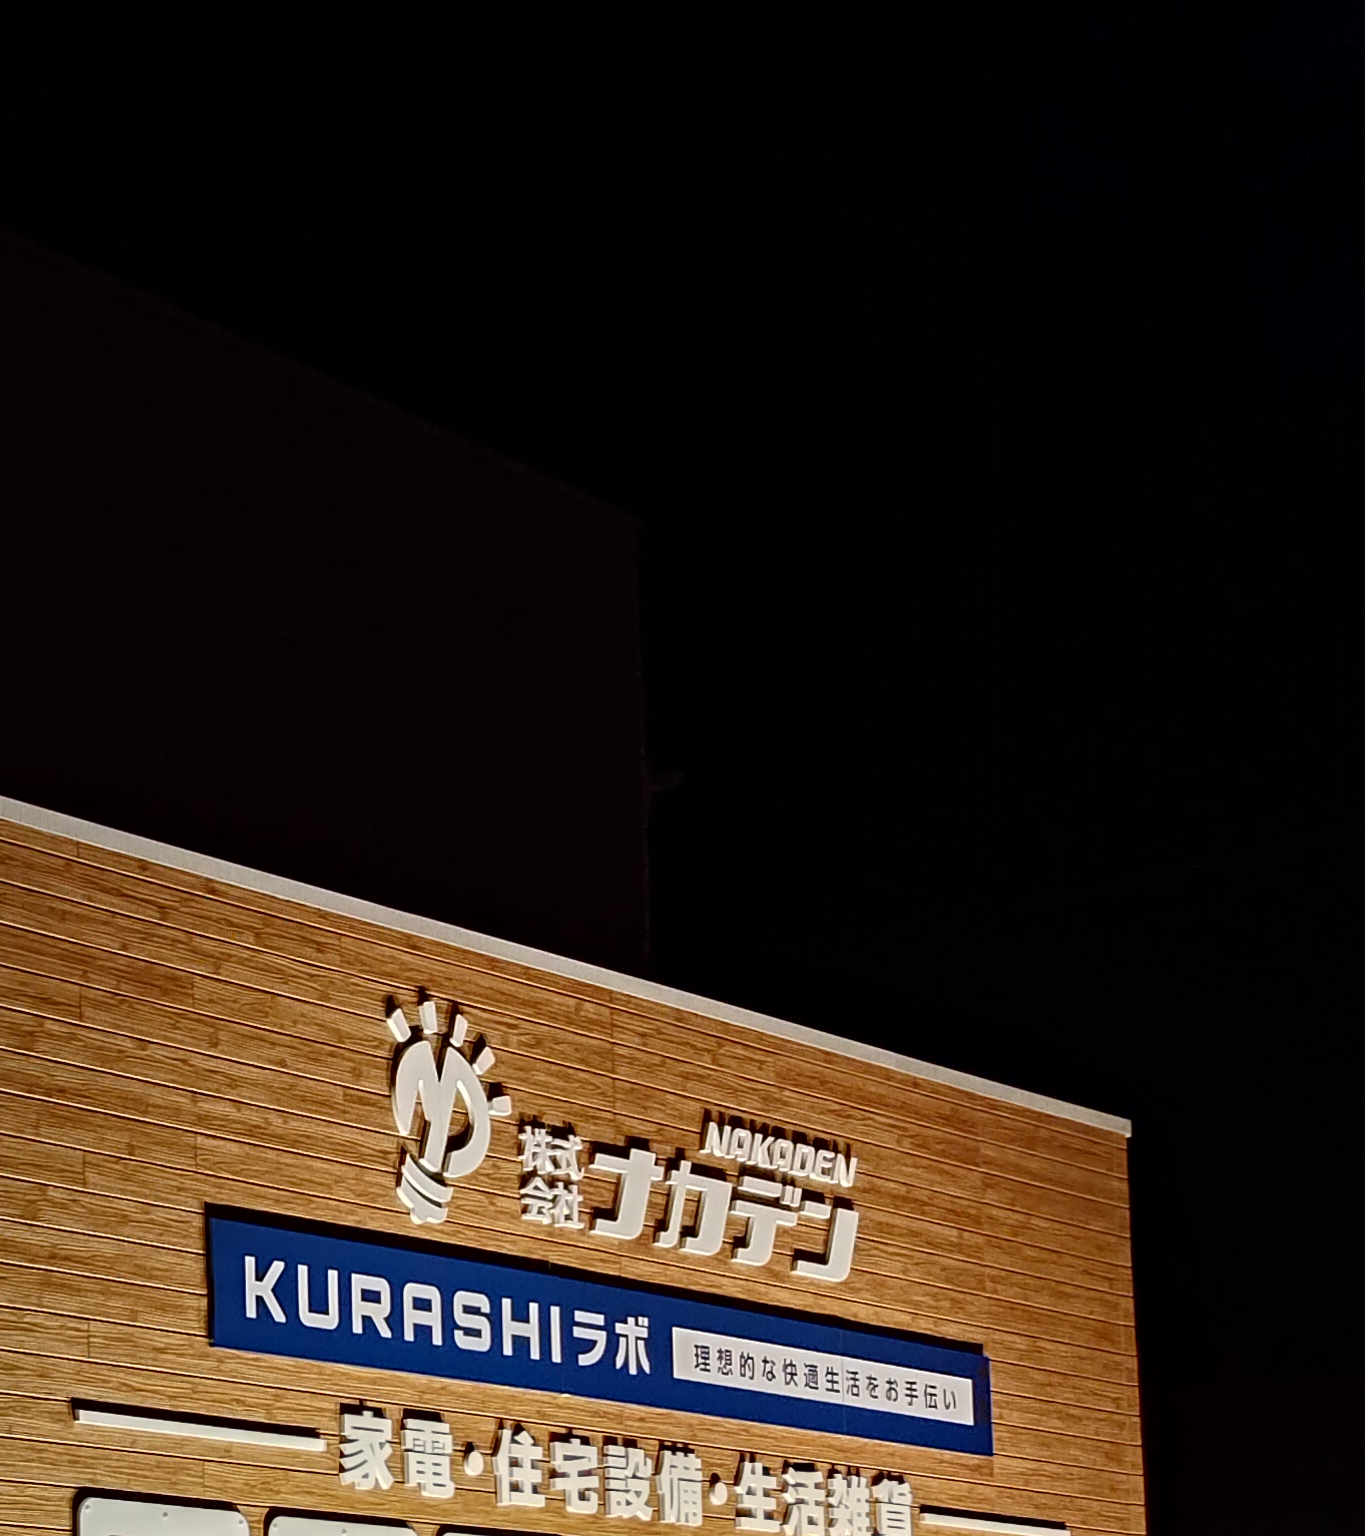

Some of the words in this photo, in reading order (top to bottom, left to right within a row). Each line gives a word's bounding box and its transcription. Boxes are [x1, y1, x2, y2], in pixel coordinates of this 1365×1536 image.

[699, 1121, 857, 1187] NAKADEN
[589, 1148, 860, 1282] ナカデン
[243, 1254, 652, 1376] KURASHIラボ
[693, 1343, 958, 1411] 理想的な快適生活をお手伝い
